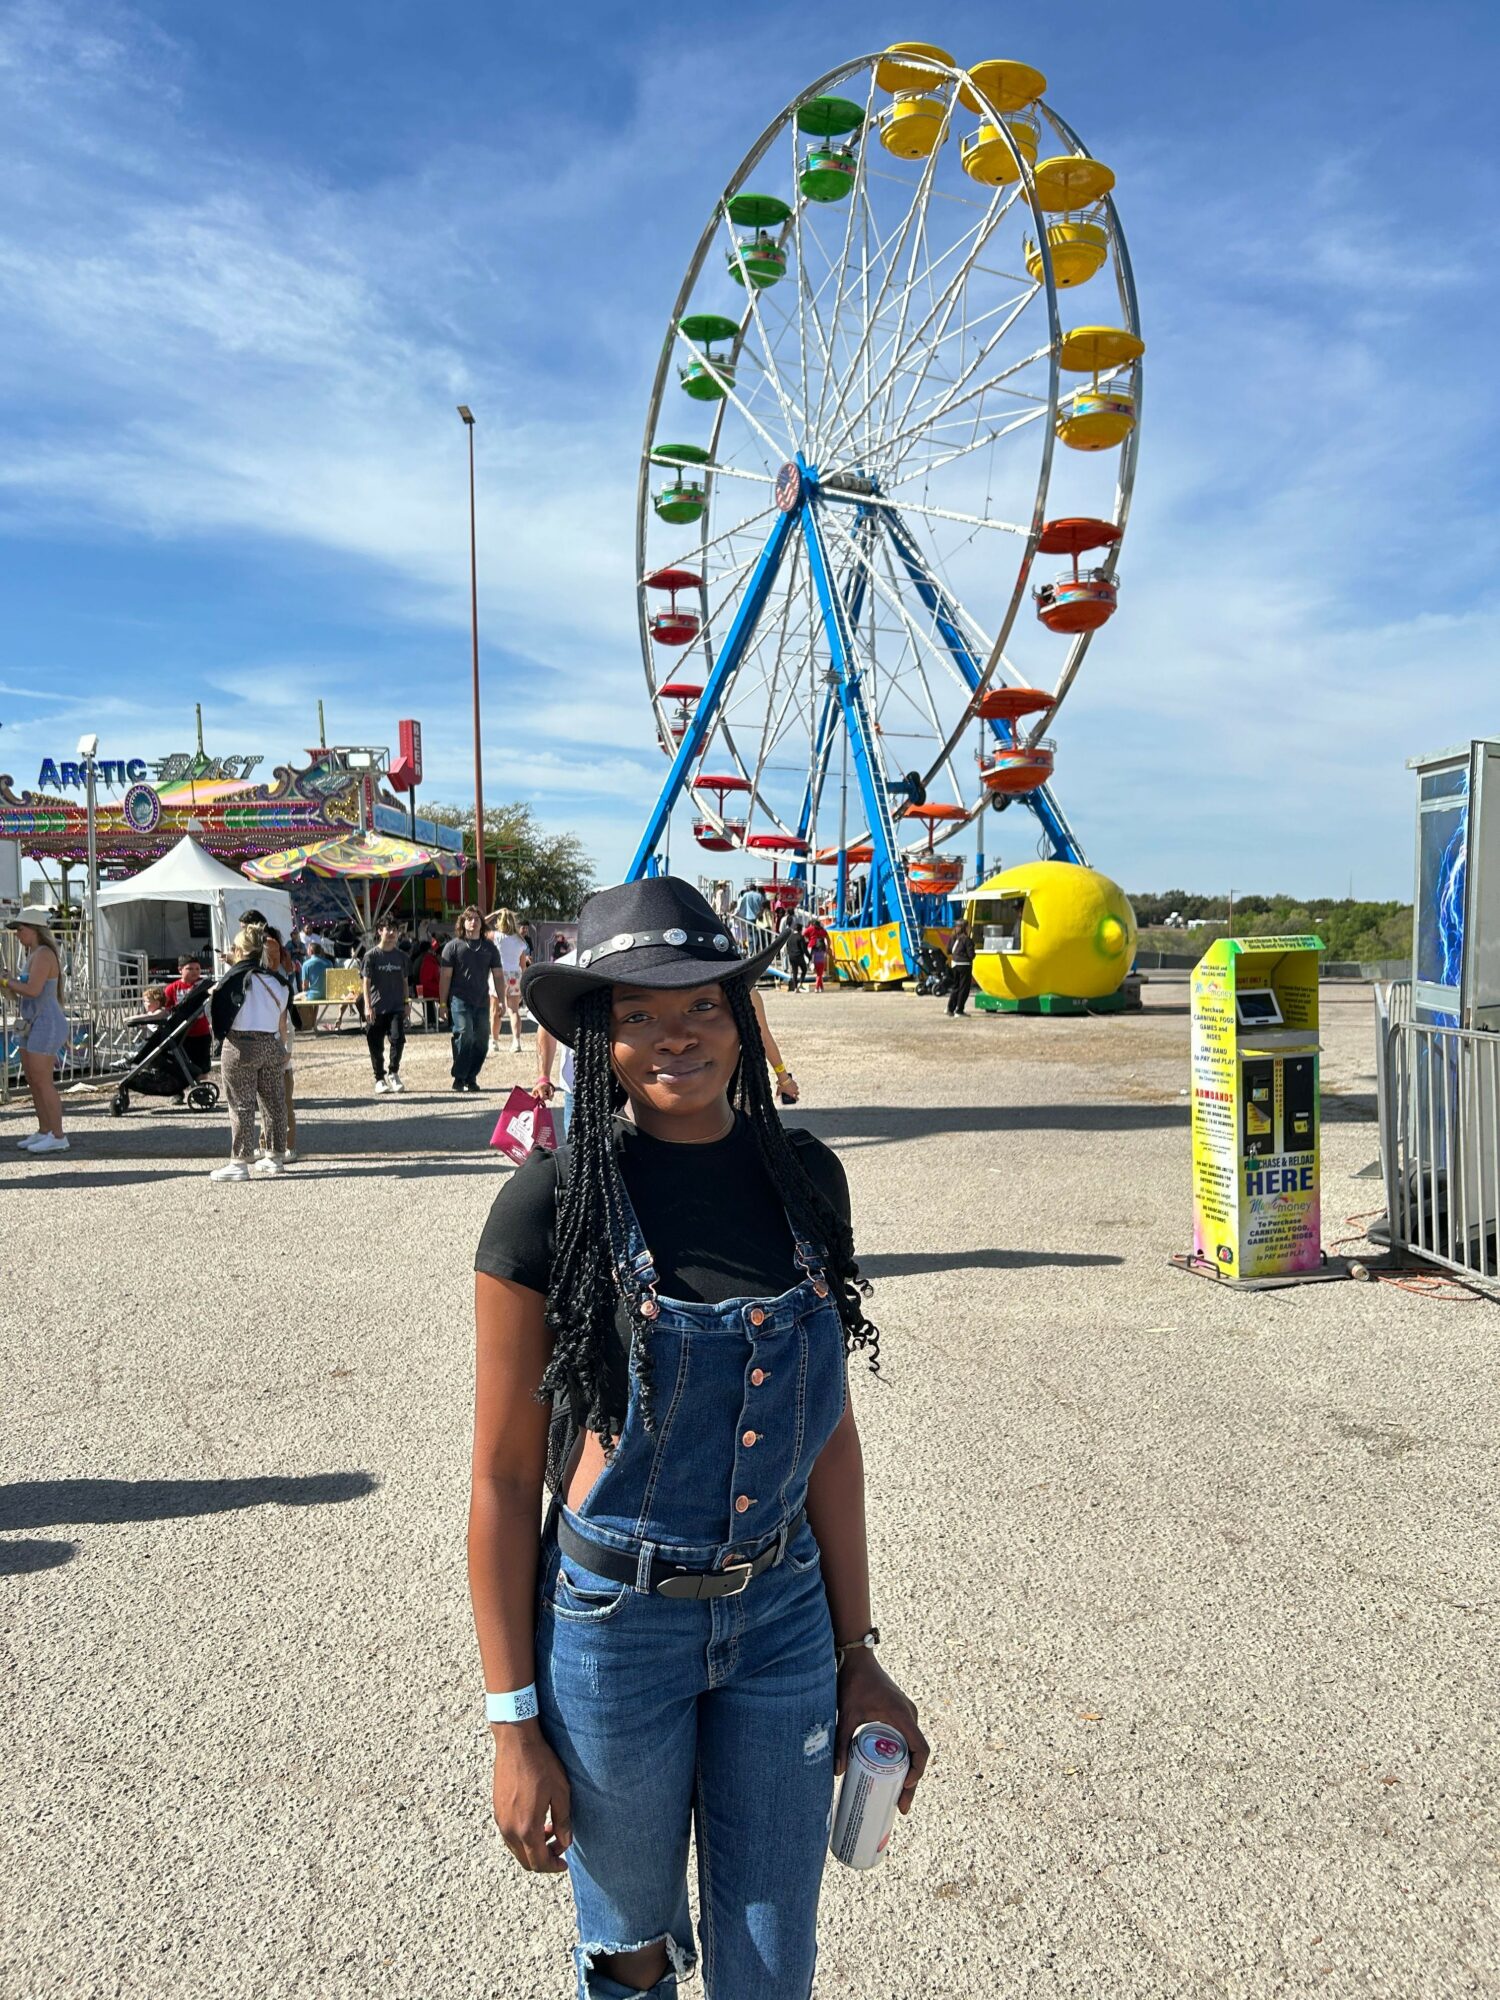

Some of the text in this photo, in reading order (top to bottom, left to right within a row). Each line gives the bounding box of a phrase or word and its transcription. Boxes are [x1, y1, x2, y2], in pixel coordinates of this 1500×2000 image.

[413, 722, 421, 776] BEER
[38, 753, 264, 793] ARCTIC BLAST
[1196, 1088, 1233, 1103] ARMBANDS
[1244, 1155, 1314, 1170] PCHASE & RELOAD
[1246, 1167, 1314, 1197] HERE
[1278, 1202, 1311, 1212] money
[1268, 1218, 1301, 1227] Purchase
[1250, 1227, 1286, 1237] CARNIVAL
[1248, 1236, 1274, 1245] GAMES
